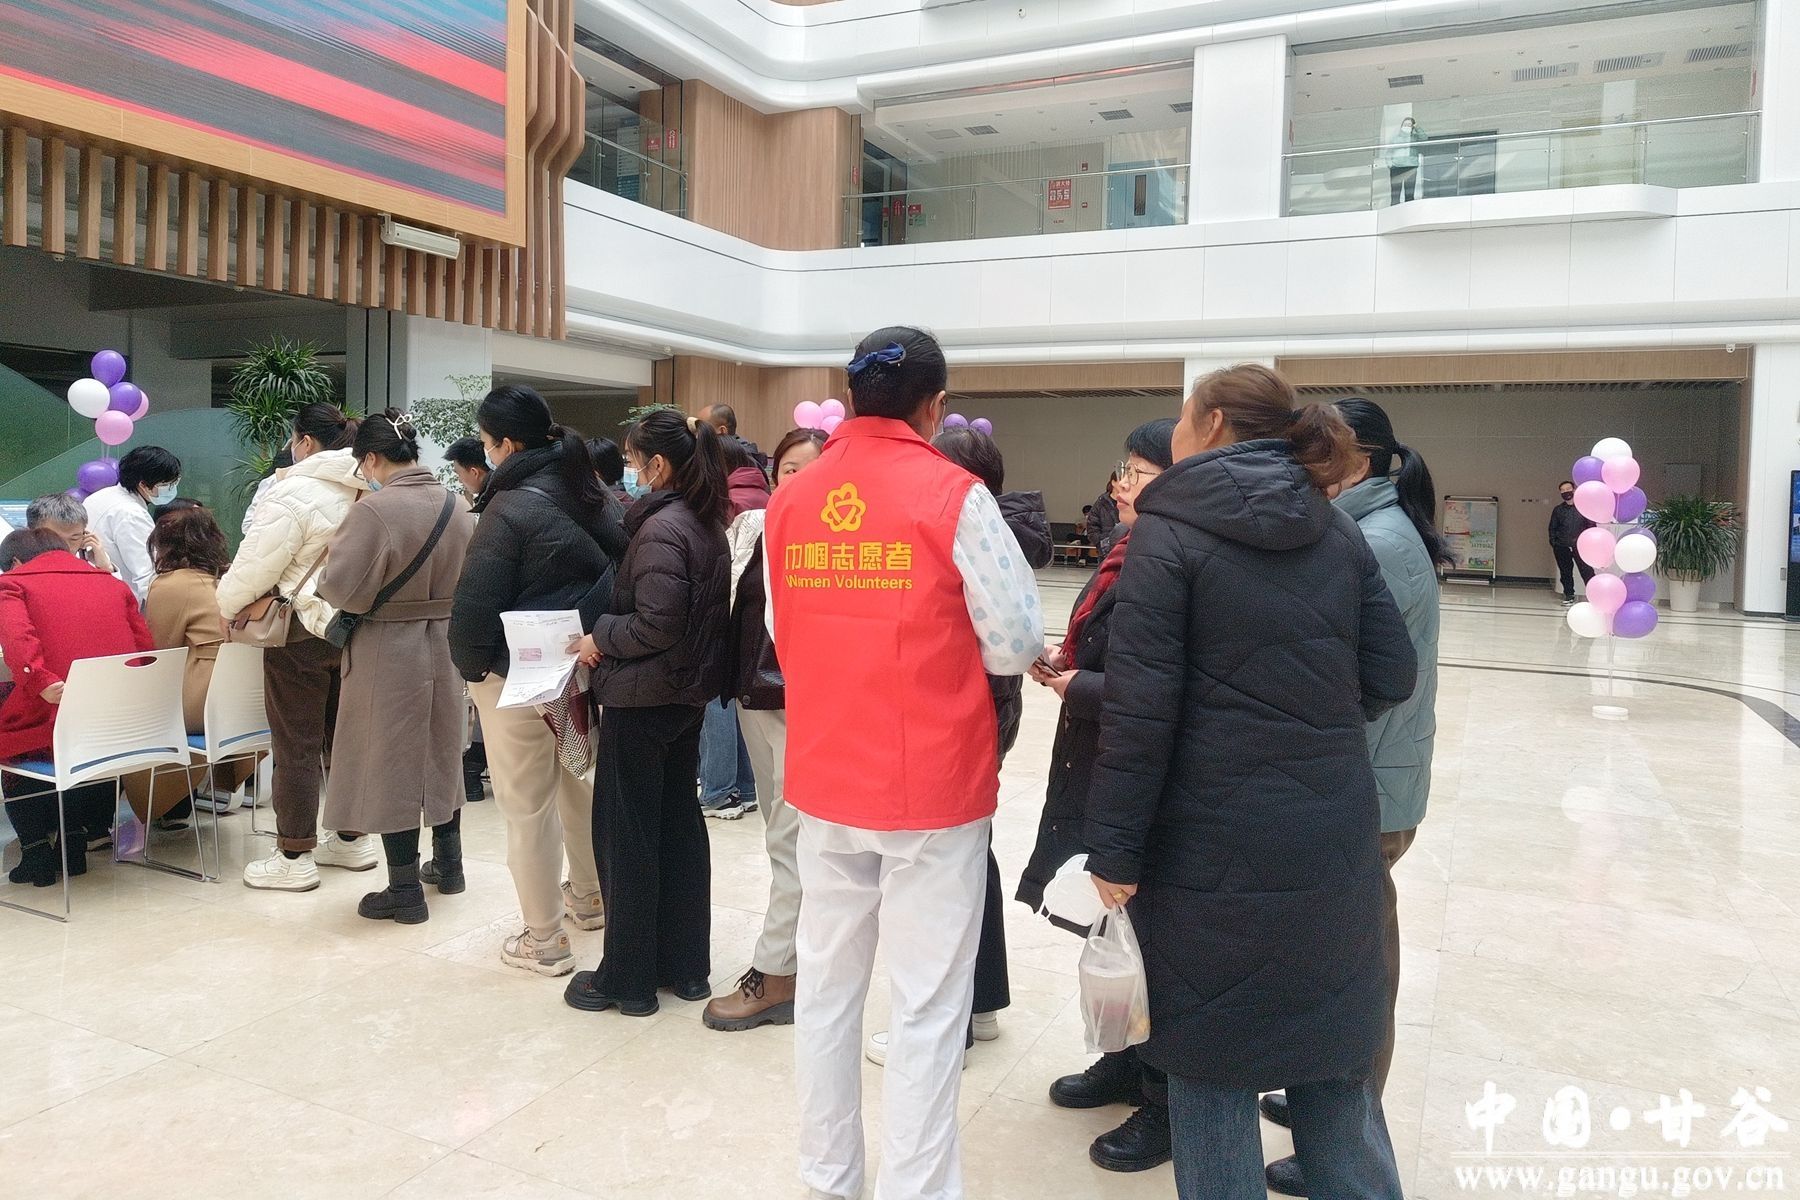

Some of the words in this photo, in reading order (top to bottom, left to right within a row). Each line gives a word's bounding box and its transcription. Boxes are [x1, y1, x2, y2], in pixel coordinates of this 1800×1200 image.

[784, 541, 913, 571] 巾帼志愿者
[834, 574, 913, 590] Volunteers
